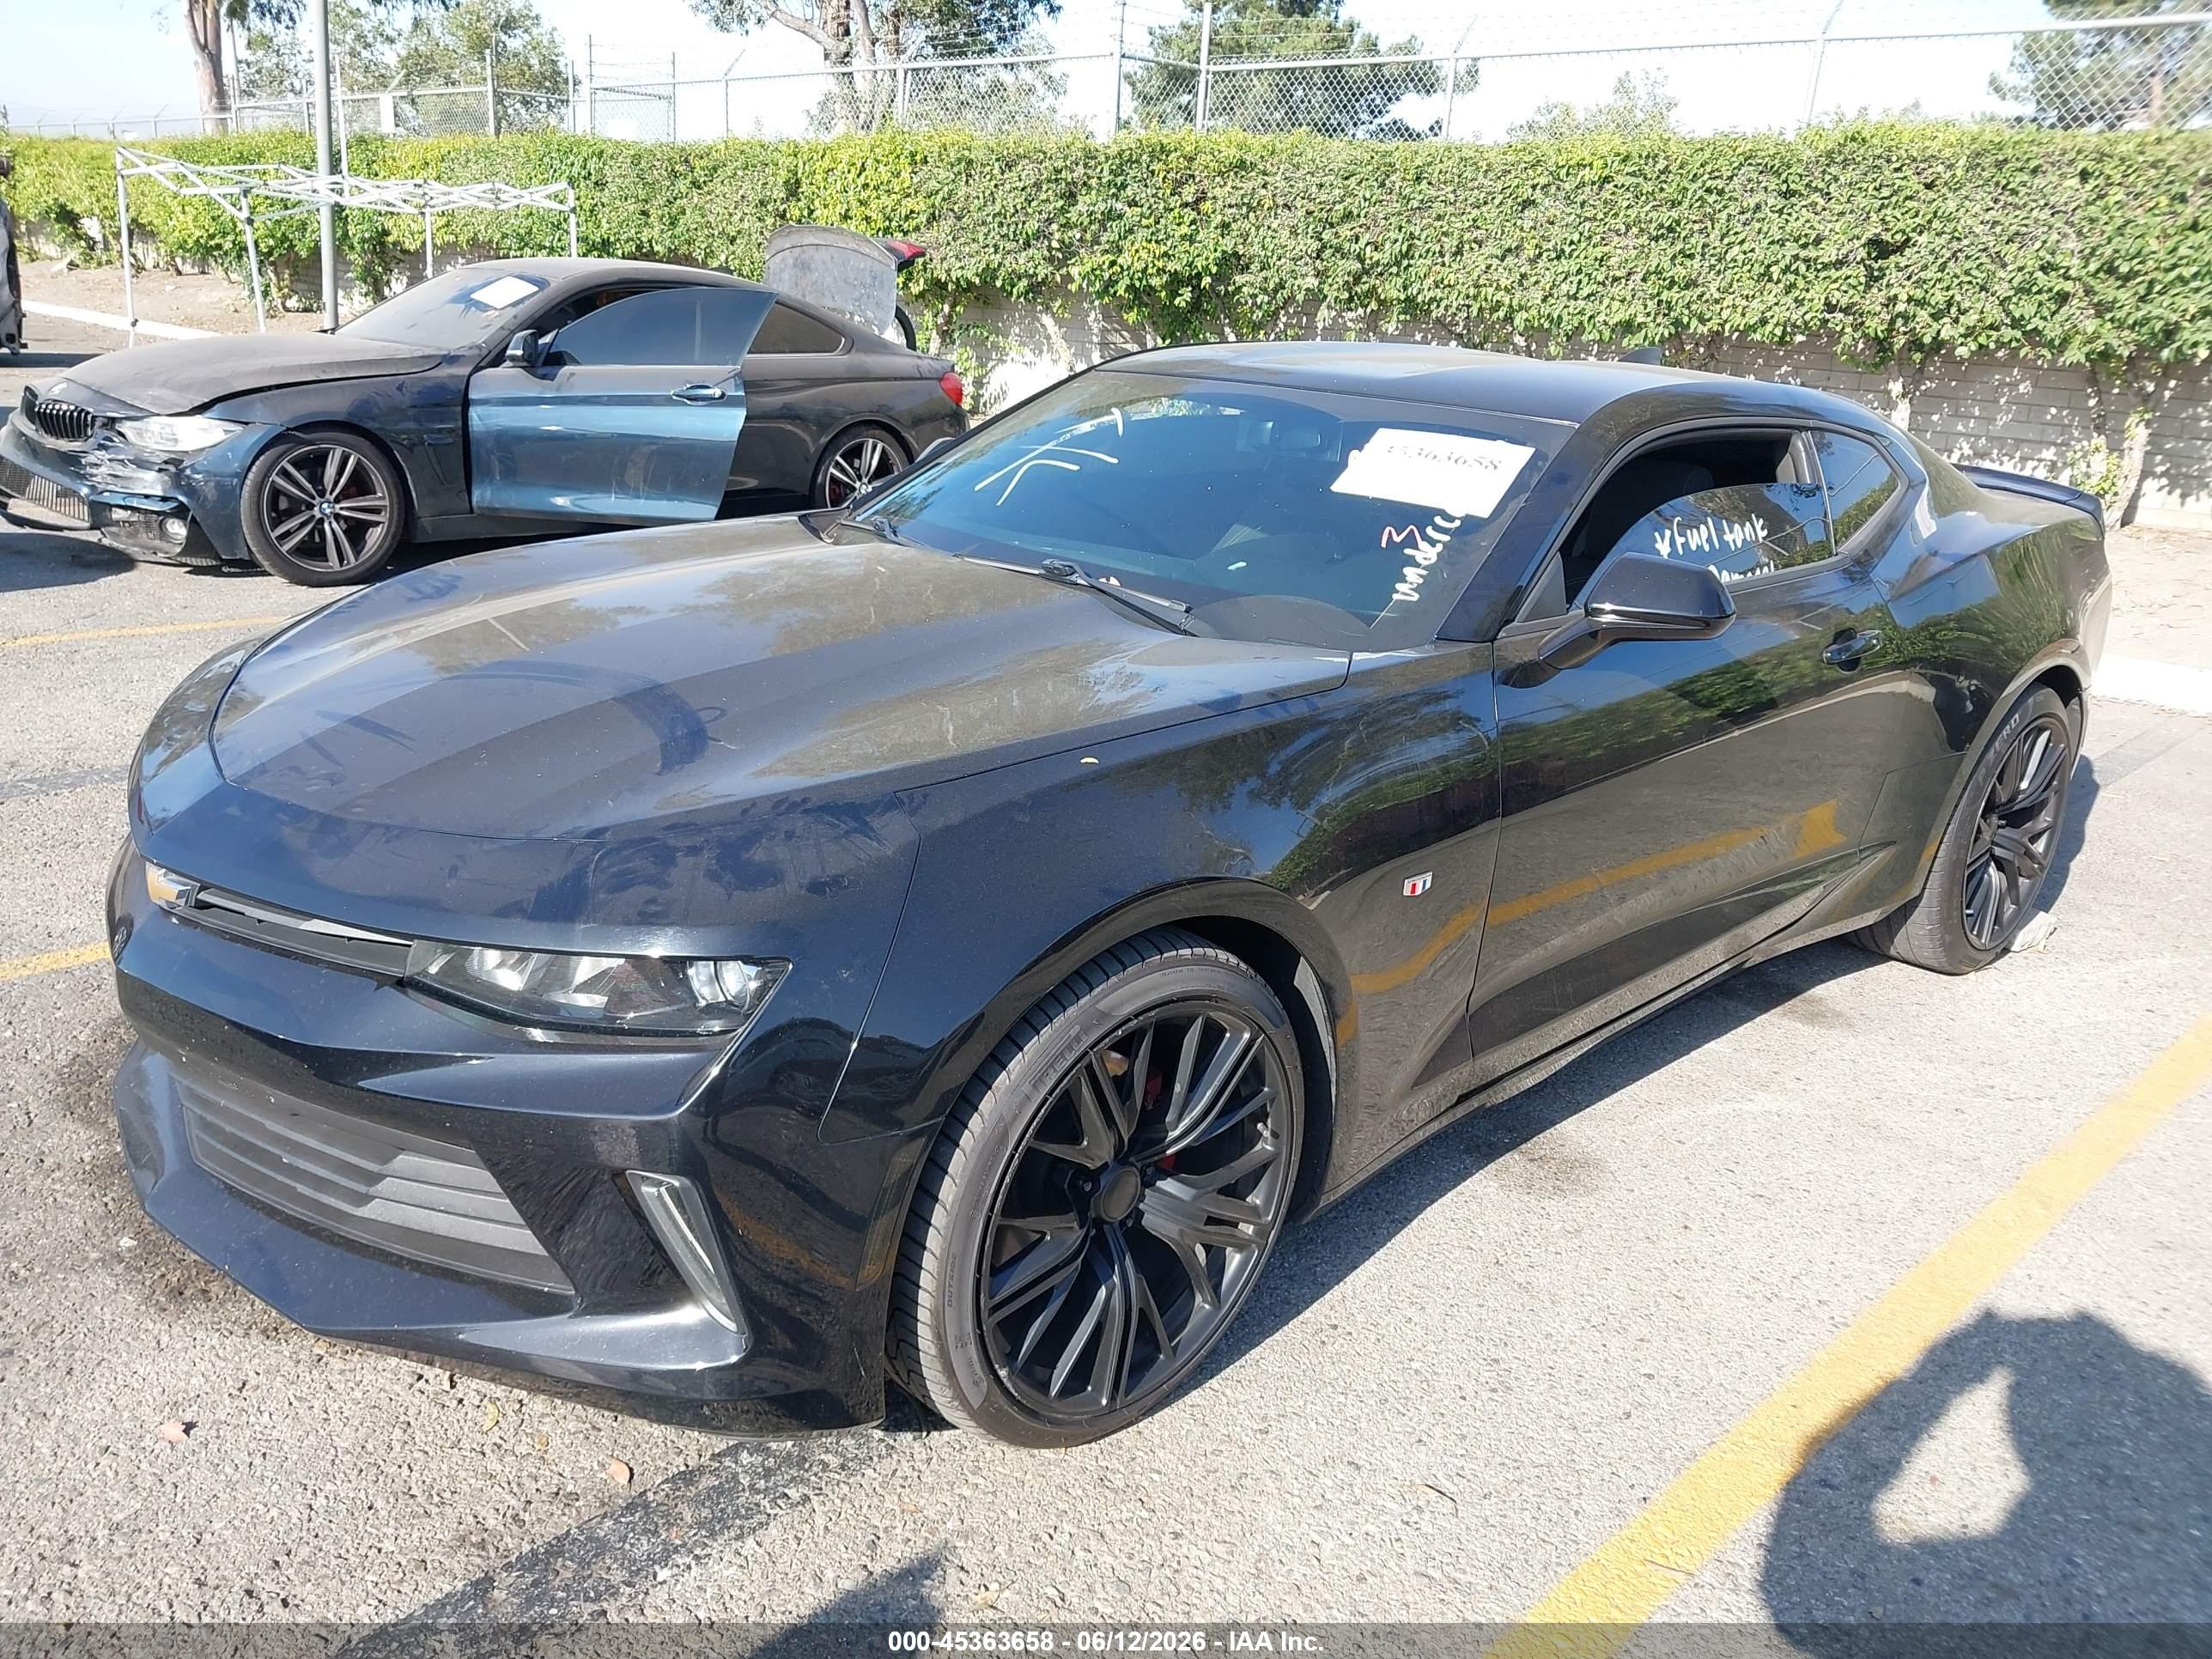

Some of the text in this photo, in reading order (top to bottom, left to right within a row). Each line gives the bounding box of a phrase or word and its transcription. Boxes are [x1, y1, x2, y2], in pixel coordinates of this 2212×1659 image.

[1392, 514, 1462, 602] underc
[1674, 513, 1768, 556] Fuel tank
[1022, 1024, 1089, 1103] PIRELLI
[946, 1254, 957, 1308] OUTSIDE
